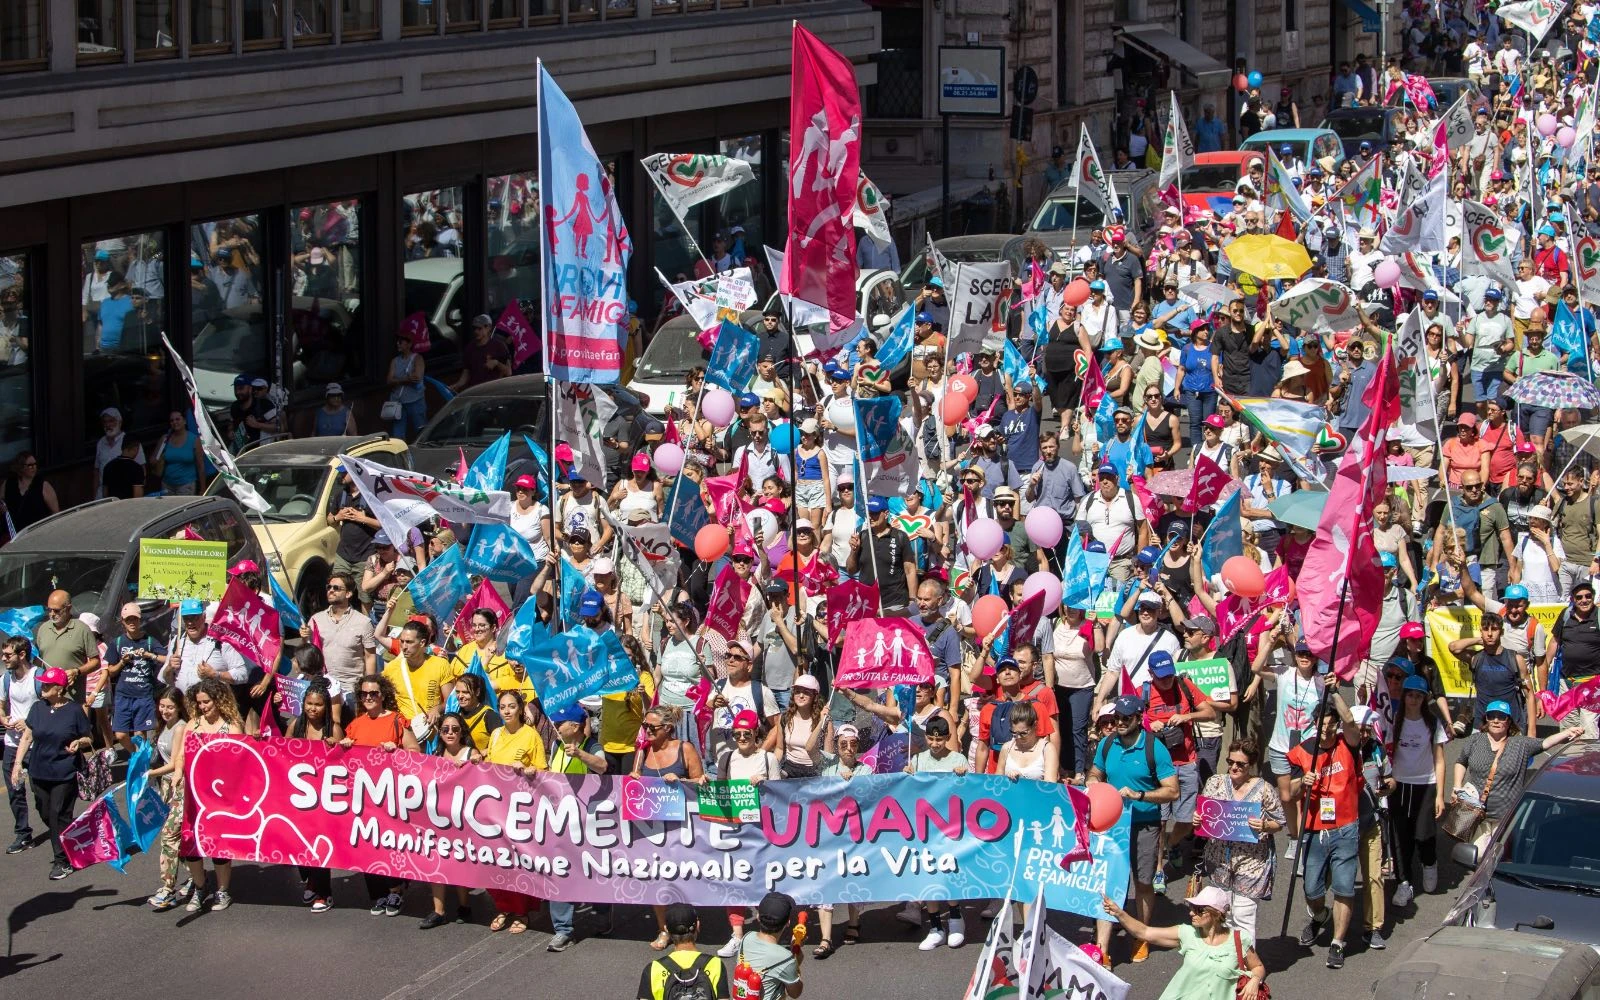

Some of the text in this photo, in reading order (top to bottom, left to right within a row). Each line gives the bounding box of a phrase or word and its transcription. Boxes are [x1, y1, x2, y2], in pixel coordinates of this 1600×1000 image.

[209, 622, 241, 643] PROVITA
[1200, 666, 1226, 675] VITA
[839, 672, 930, 683] PROVITA & FAMIGLIA
[1197, 676, 1227, 685] DONO
[543, 685, 577, 709] PROVITA
[646, 786, 665, 794] VIVA
[698, 785, 755, 793] NOI SIAMO
[657, 795, 679, 803] VITA!
[700, 798, 757, 807] PER LA VITA
[760, 795, 1012, 848] UMANO
[350, 816, 960, 891] Manifestazione Nazionale per la Vita
[1023, 865, 1107, 894] & FAMIGLIA
